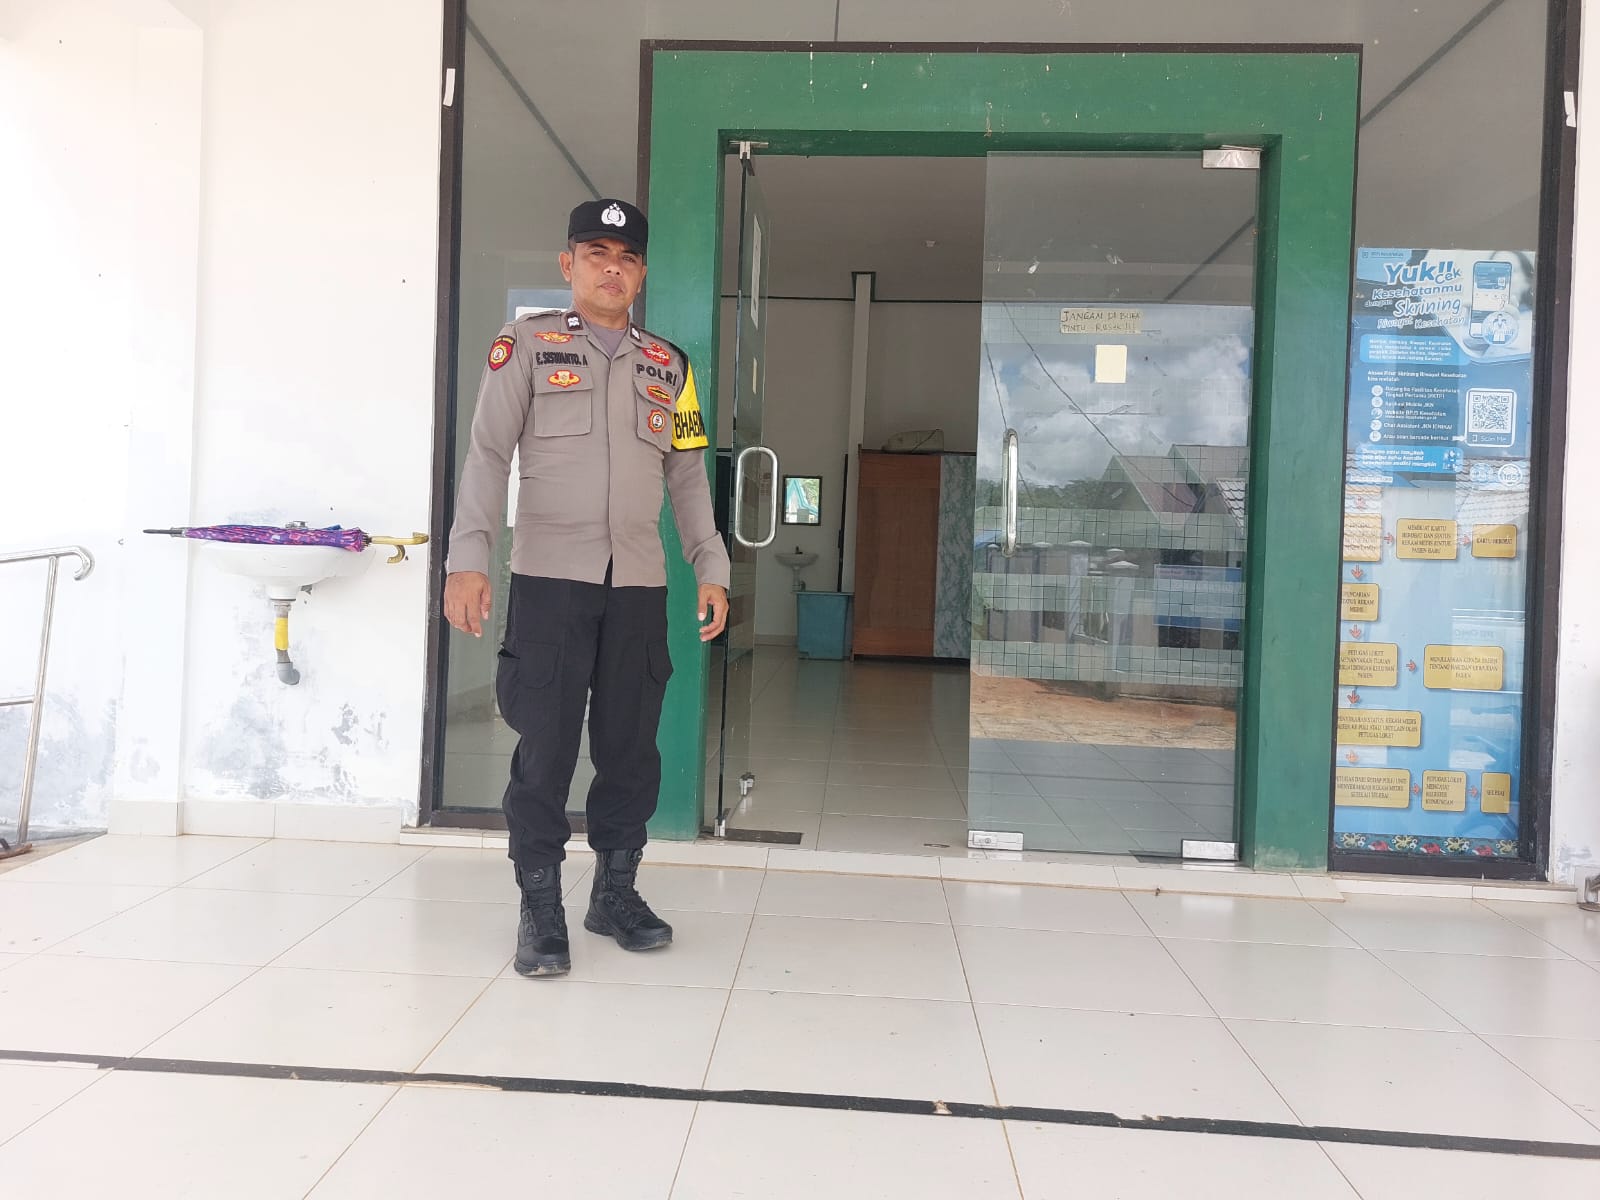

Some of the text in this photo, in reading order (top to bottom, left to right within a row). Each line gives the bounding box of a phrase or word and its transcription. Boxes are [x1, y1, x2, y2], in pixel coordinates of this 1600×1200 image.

[1384, 261, 1454, 284] Yuk!!
[1434, 268, 1461, 284] Cek
[1372, 284, 1462, 300] Kesehatanmu
[1393, 298, 1461, 317] Skrining
[636, 363, 678, 387] POLRI
